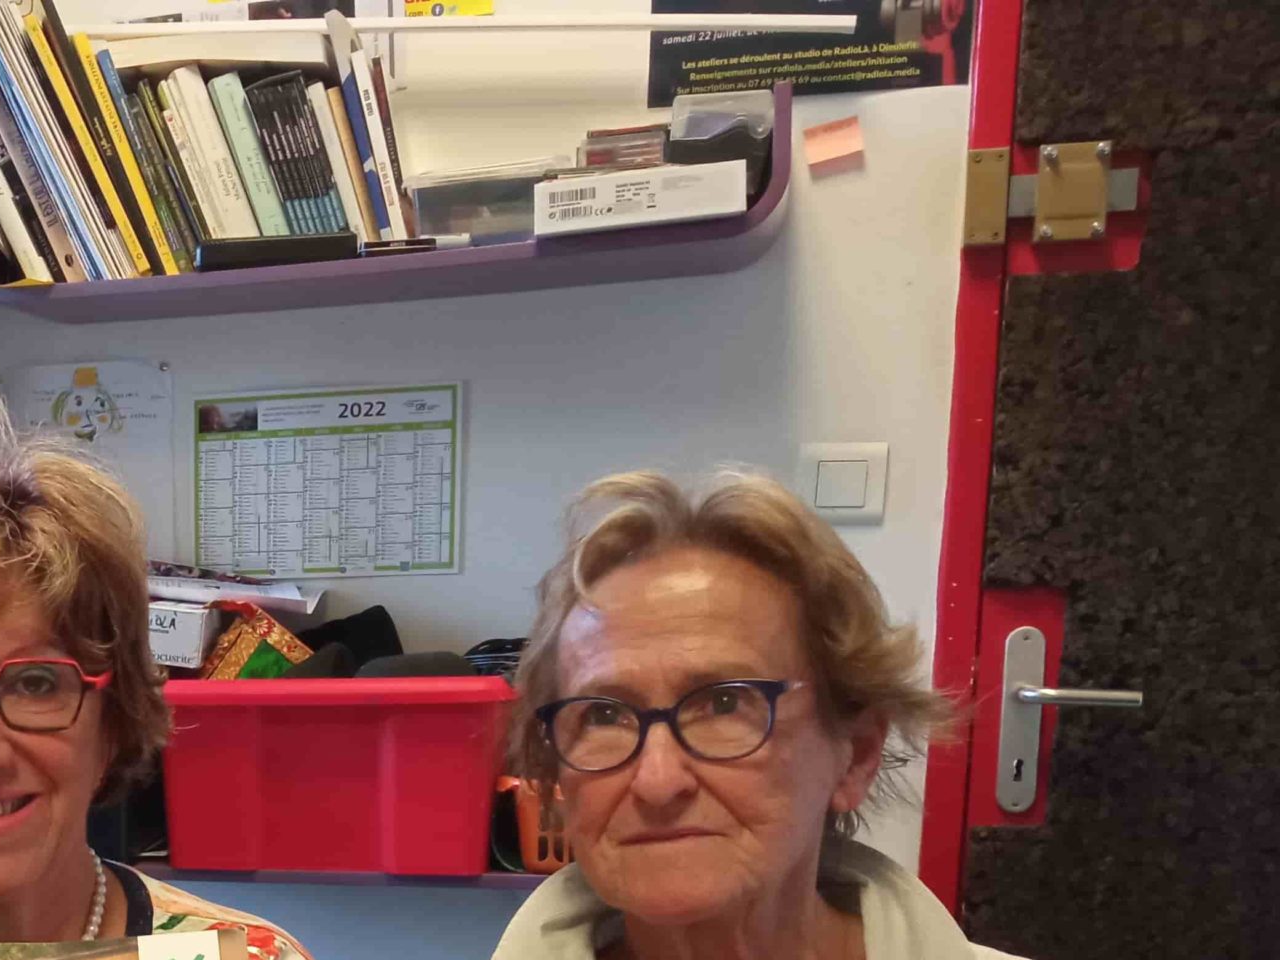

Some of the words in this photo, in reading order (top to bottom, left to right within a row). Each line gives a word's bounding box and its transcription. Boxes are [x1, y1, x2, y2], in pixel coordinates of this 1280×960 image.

[662, 33, 696, 45] samedi
[698, 31, 711, 41] 22
[682, 60, 695, 69] Les
[696, 57, 728, 68] ateliers
[740, 53, 781, 64] déroulent
[794, 49, 819, 60] studio
[690, 67, 757, 81] Renseignements
[759, 66, 771, 74] sur
[692, 82, 734, 95] inscription
[748, 79, 759, 89] 07
[338, 401, 386, 418] 2022
